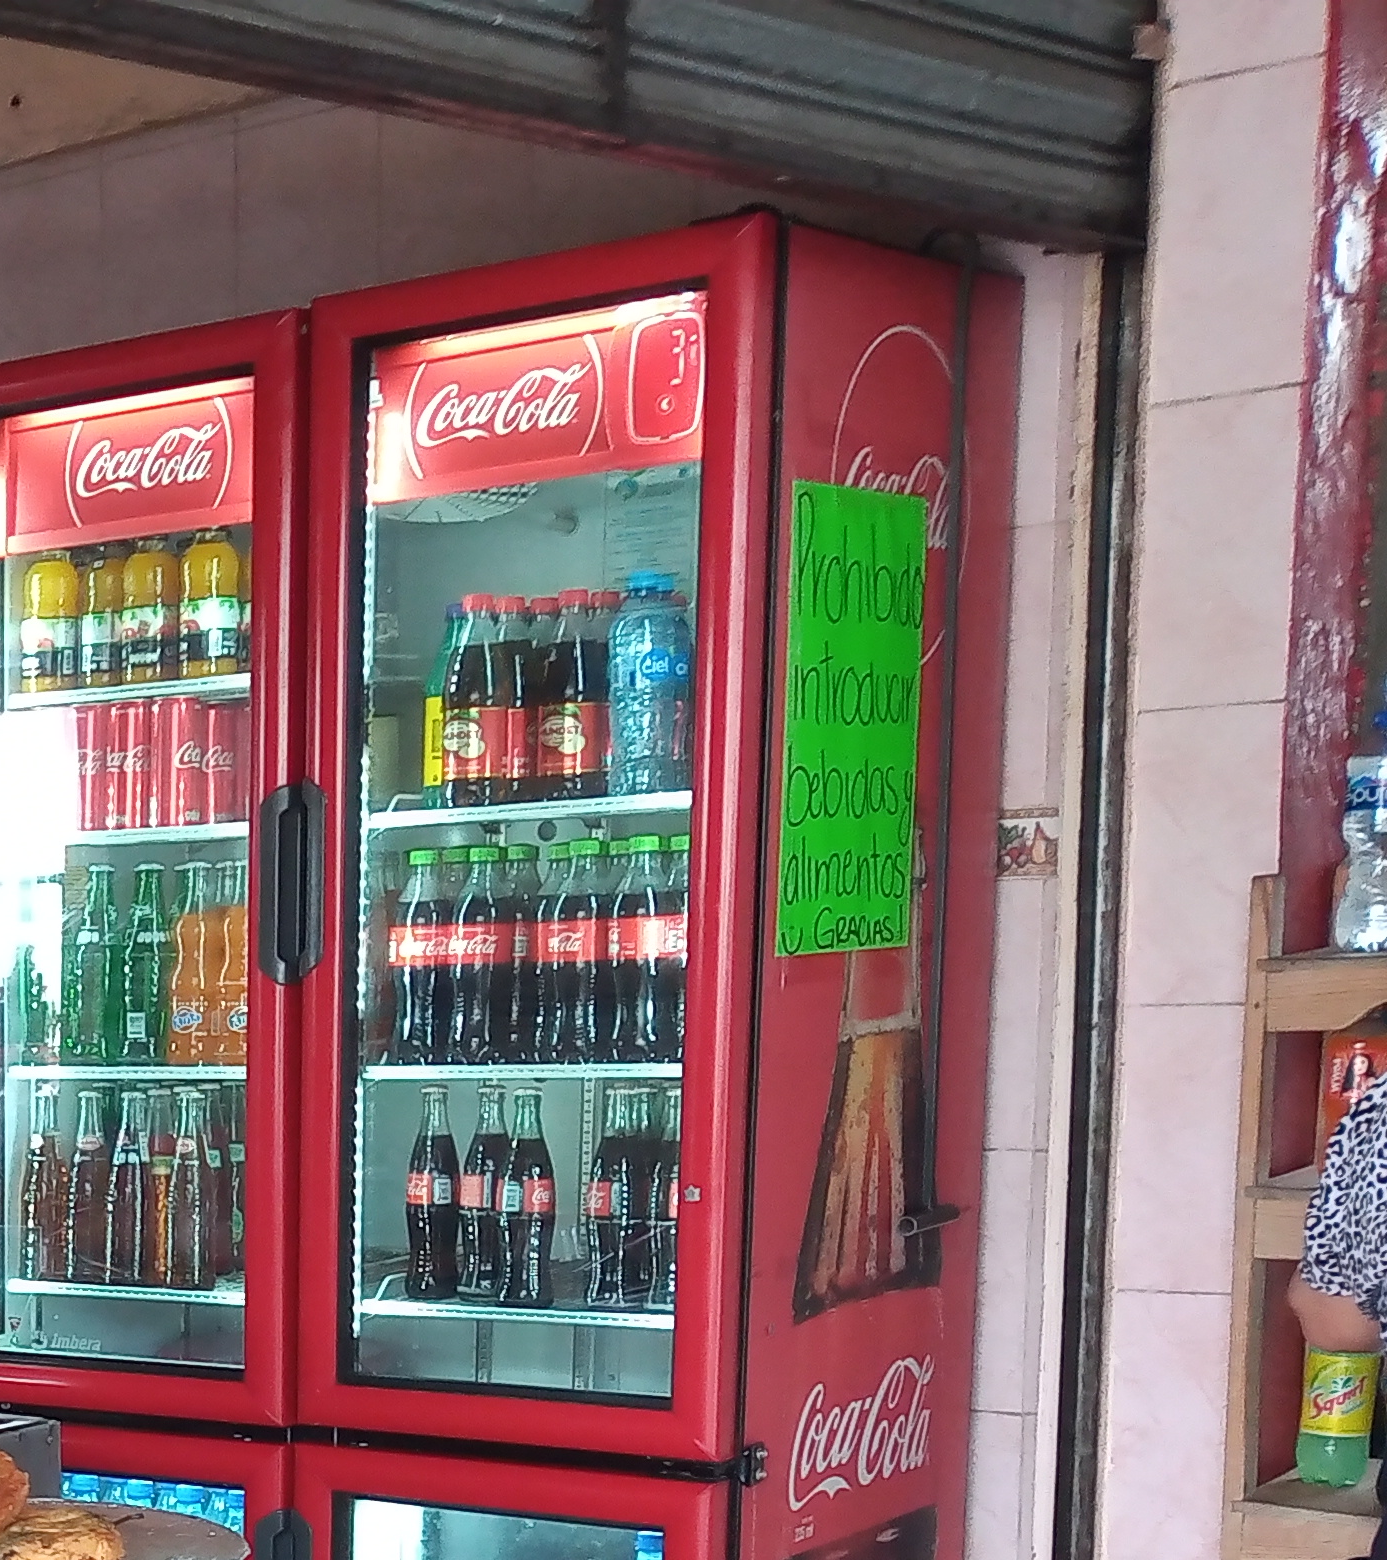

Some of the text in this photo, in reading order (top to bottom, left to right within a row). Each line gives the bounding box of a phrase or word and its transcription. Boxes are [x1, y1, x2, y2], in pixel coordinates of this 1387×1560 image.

[416, 361, 594, 448] Coca-Cola
[75, 422, 223, 499] Coca-Cola
[798, 492, 925, 629] Prohibido
[793, 640, 917, 727] introducir
[787, 745, 915, 847] bebidas y
[784, 831, 907, 905] alimentos
[789, 1354, 935, 1512] Coca-Cola
